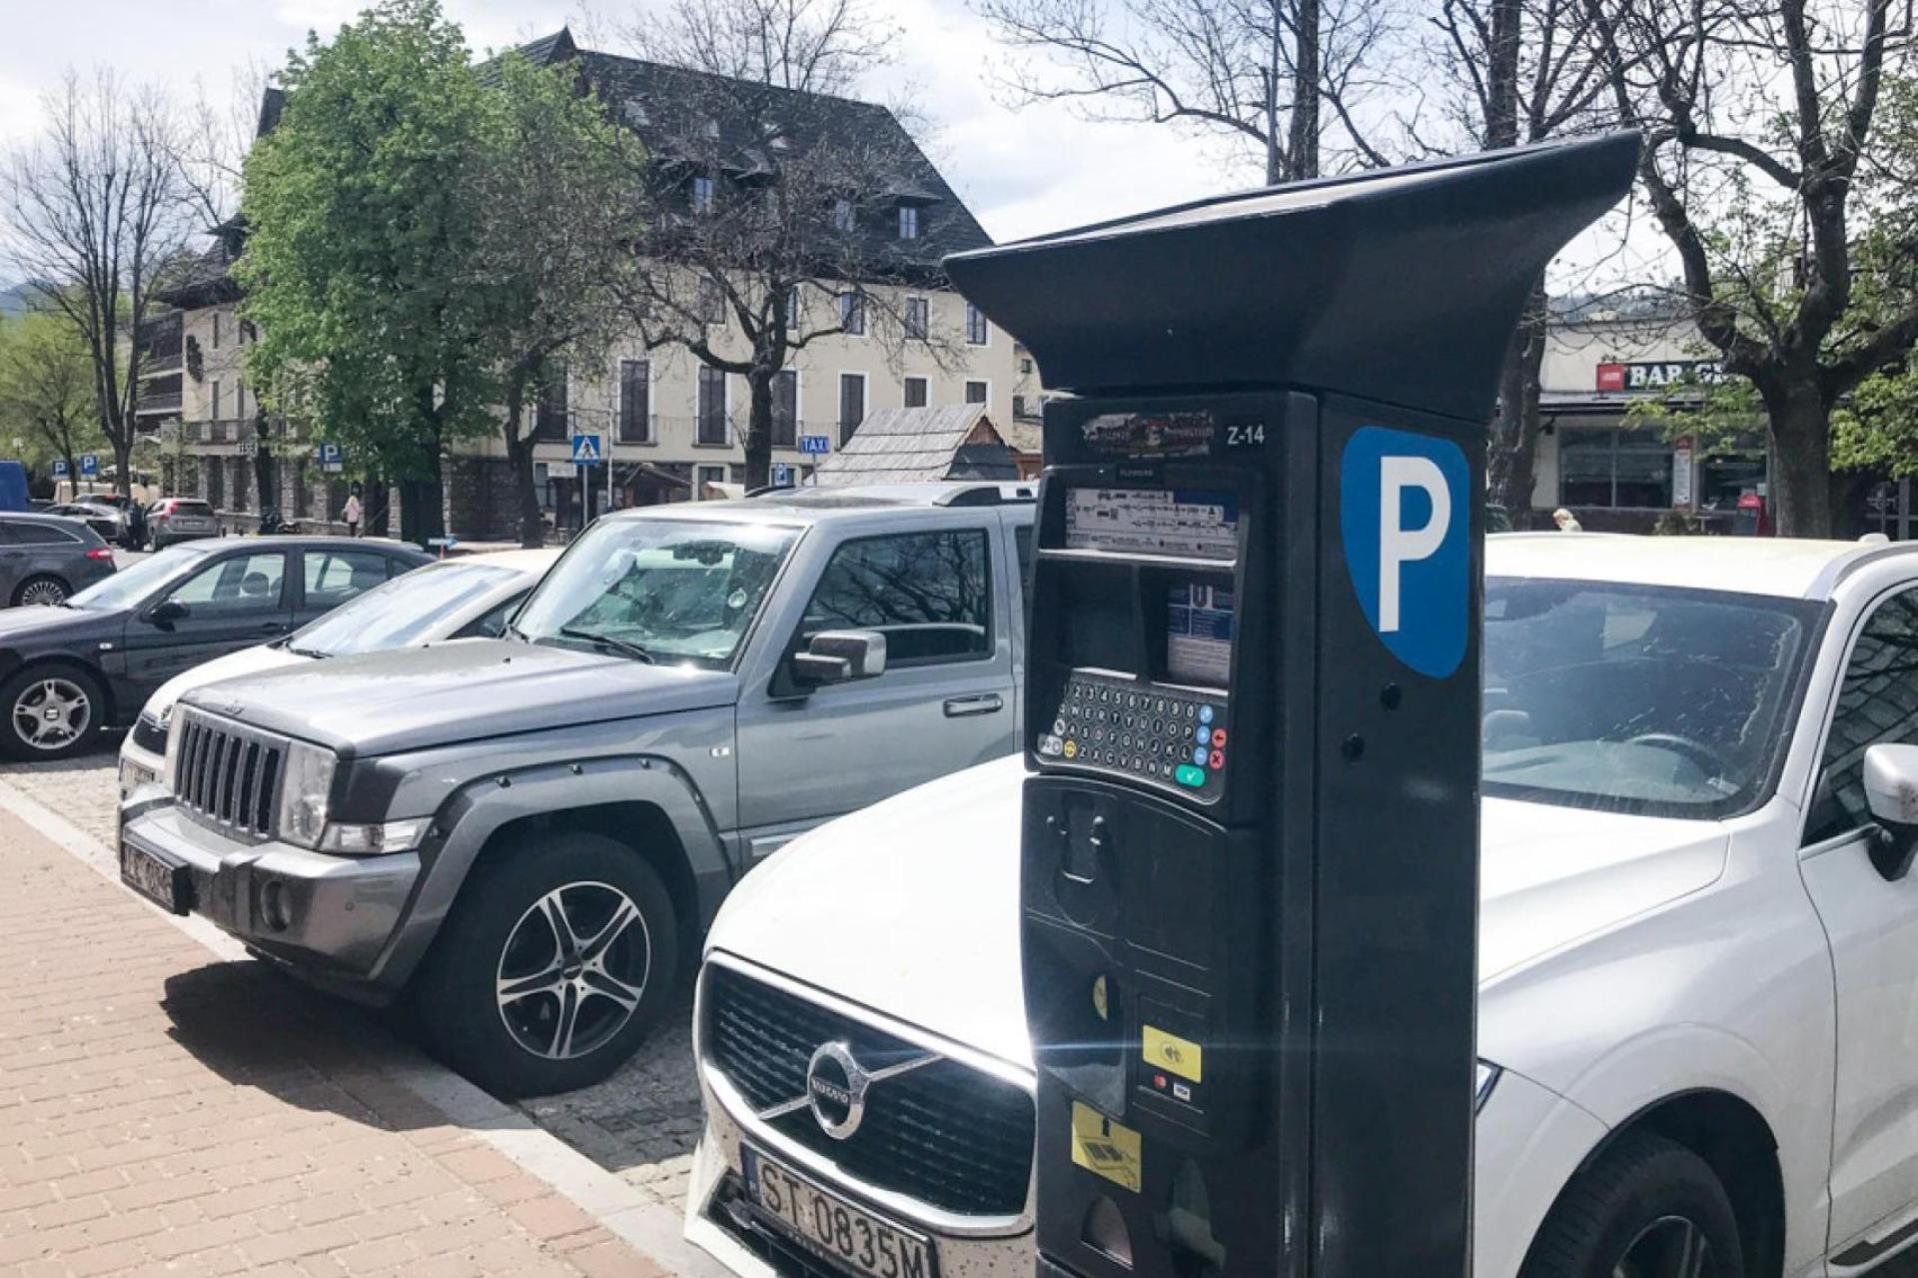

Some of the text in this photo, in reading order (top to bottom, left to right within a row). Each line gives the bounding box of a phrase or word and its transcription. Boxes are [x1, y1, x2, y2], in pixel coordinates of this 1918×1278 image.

[1629, 364, 1684, 386] BAR
[1227, 425, 1264, 445] Z-14
[83, 456, 95, 468] P
[323, 444, 338, 461] P
[54, 462, 65, 473] P
[1379, 456, 1450, 632] P
[761, 1163, 925, 1278] ST 0835M
